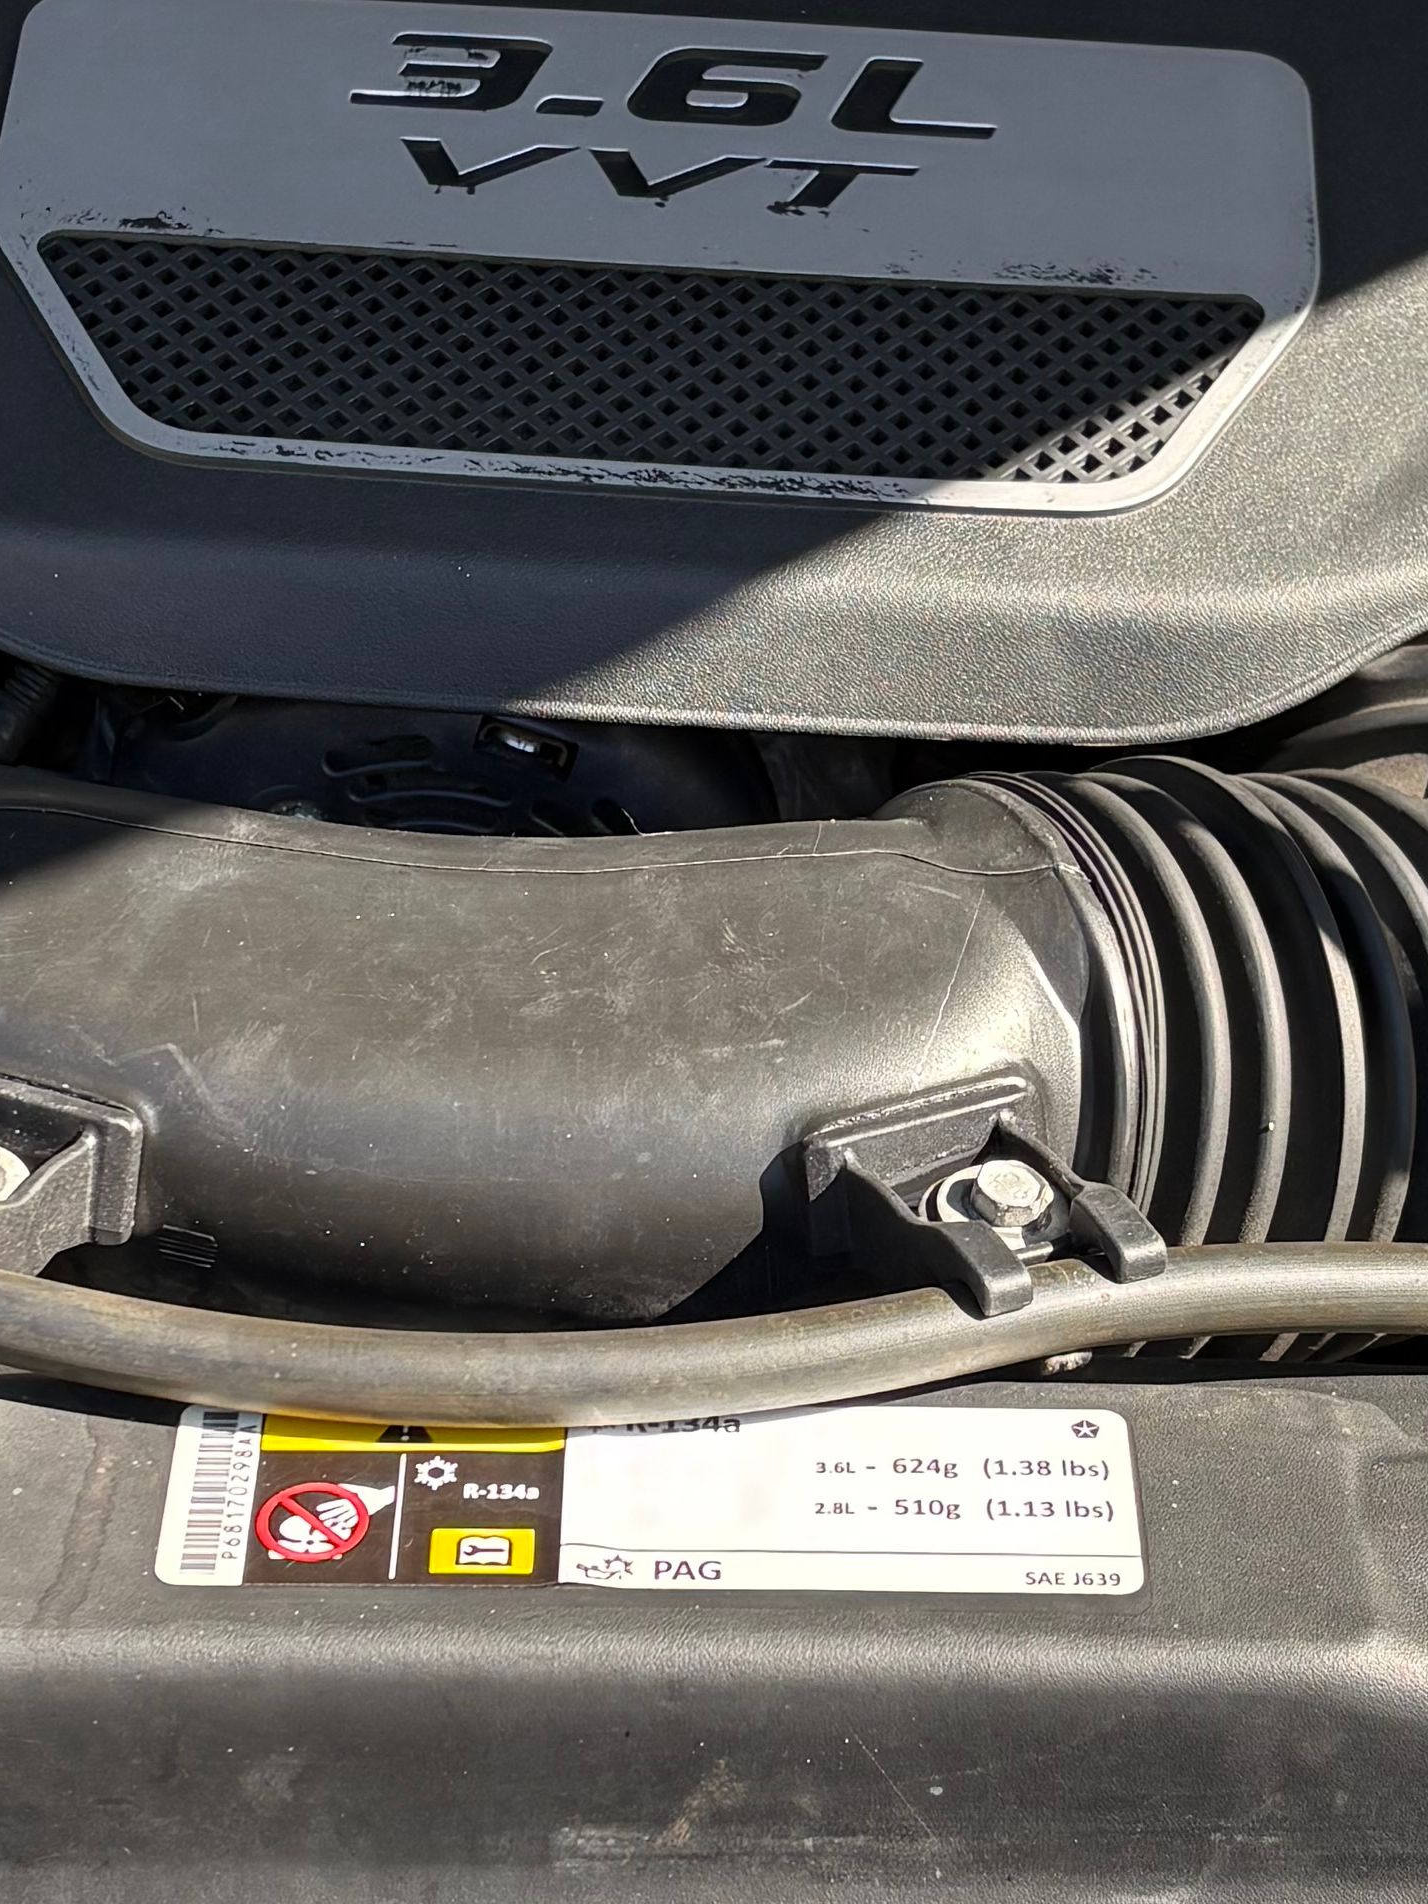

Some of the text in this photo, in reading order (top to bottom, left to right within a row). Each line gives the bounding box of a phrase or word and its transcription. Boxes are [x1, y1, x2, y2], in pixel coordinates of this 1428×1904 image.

[348, 29, 999, 141] 3.6L
[399, 134, 920, 212] VVT
[815, 1461, 856, 1475] 3.6L
[892, 1458, 959, 1479] 624g
[983, 1457, 1052, 1480] (1.38
[1061, 1459, 1110, 1481] lbs)
[462, 1482, 541, 1501] R-134a
[814, 1502, 855, 1515] 2.8L
[894, 1499, 961, 1520] 510g
[985, 1498, 1055, 1521] (1.13
[1065, 1500, 1114, 1522] lbs)
[653, 1559, 723, 1581] PAG
[1025, 1571, 1121, 1587] SAE J639
